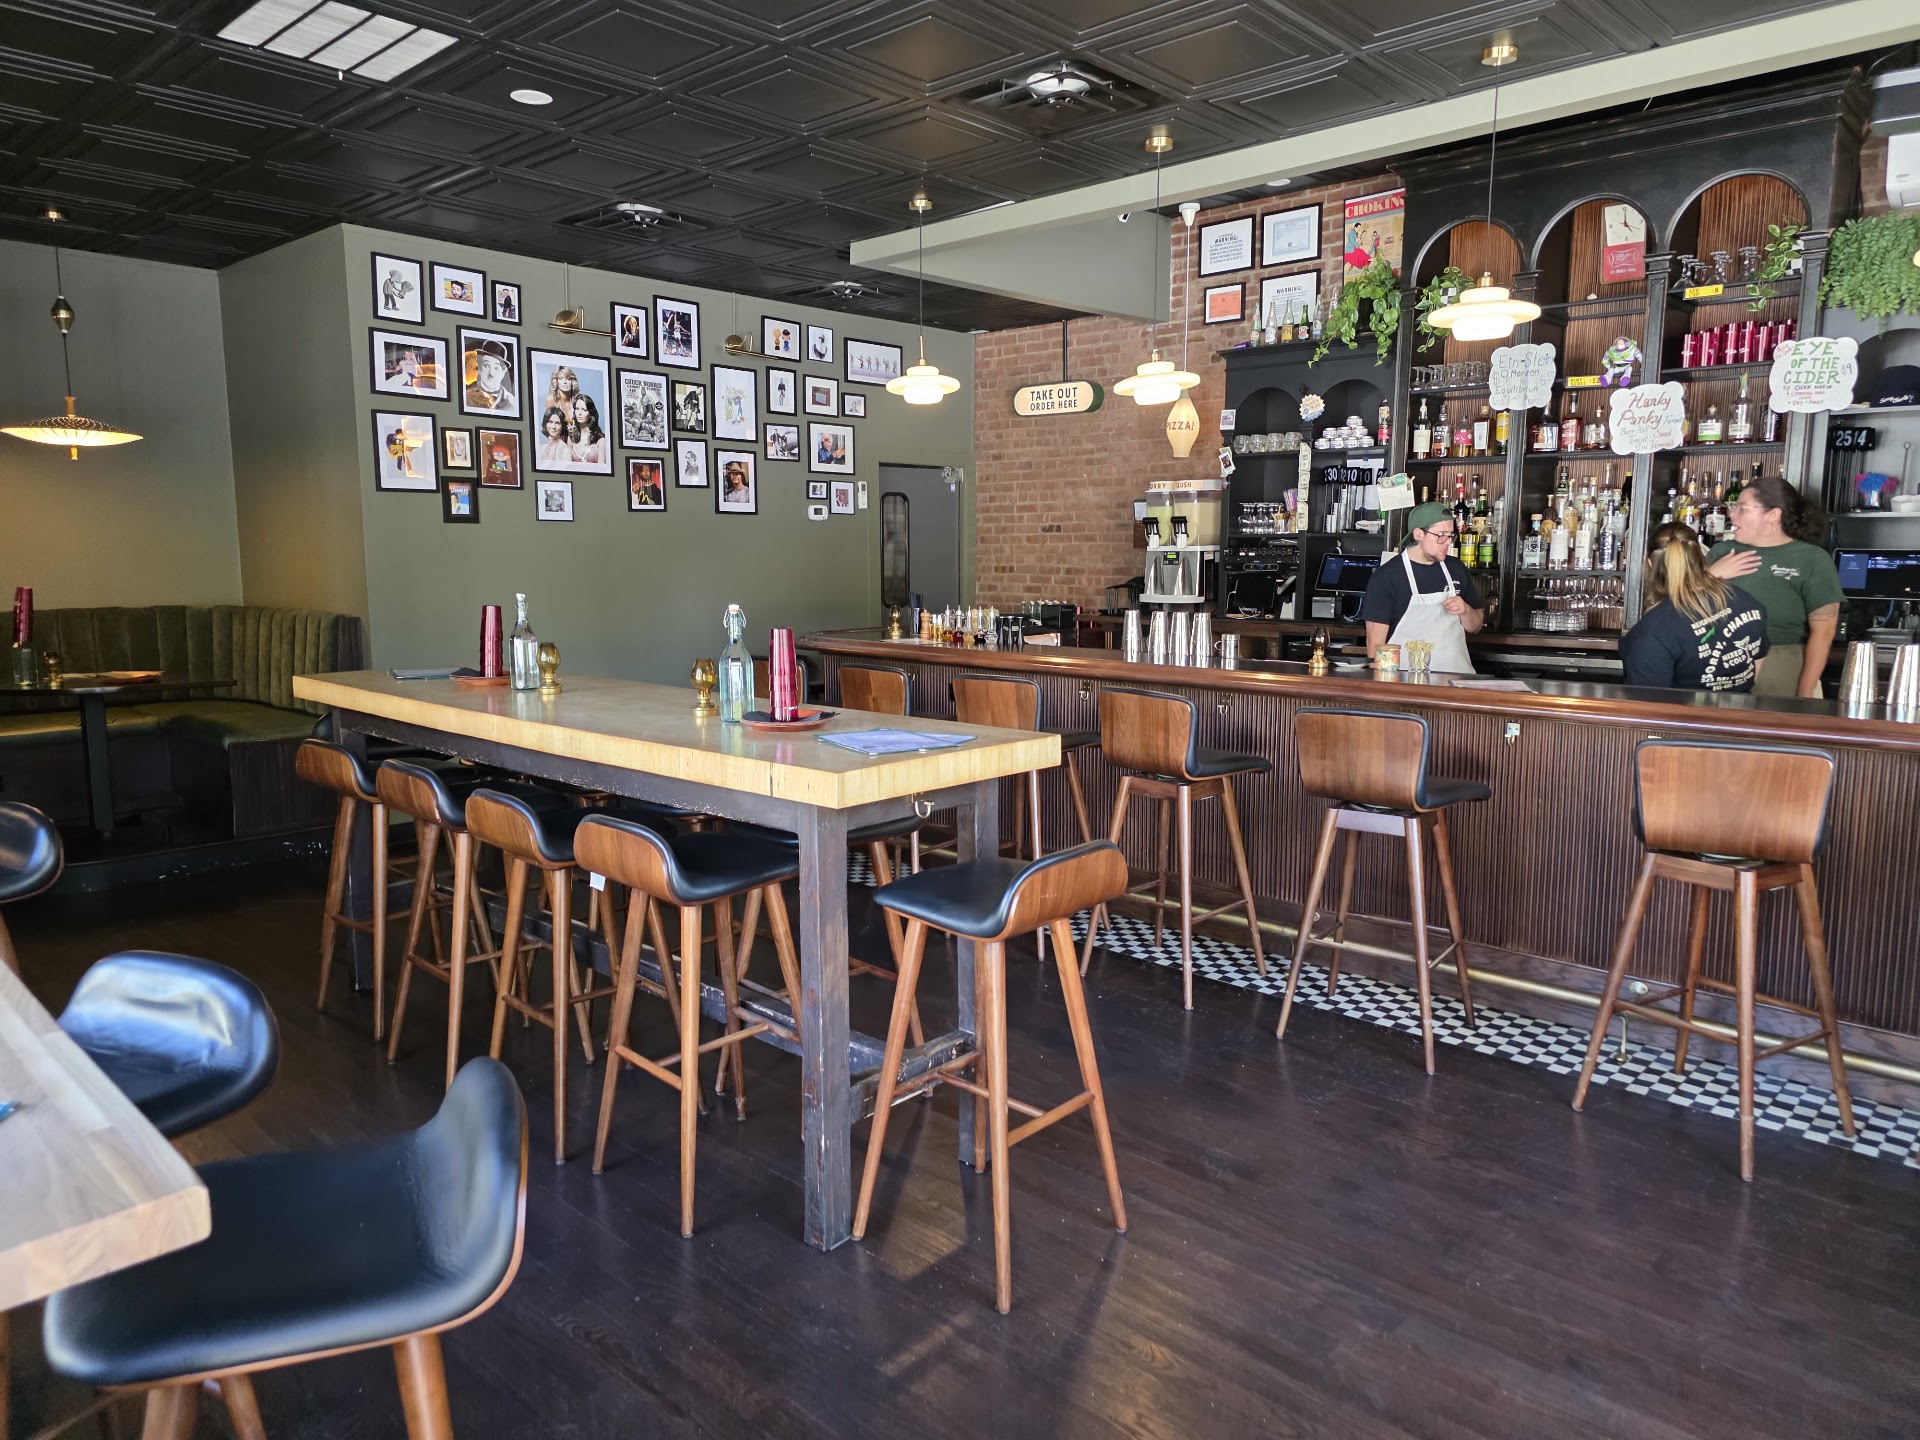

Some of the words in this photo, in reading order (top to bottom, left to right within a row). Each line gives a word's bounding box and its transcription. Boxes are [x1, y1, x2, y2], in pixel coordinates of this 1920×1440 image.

[1276, 285, 1303, 294] WARNING:
[1791, 341, 1839, 356] EYE
[1790, 358, 1808, 369] OF
[1810, 357, 1840, 369] THE
[1841, 363, 1853, 376] $9
[1783, 370, 1841, 385] CIDER
[1030, 389, 1054, 402] TAKE
[1057, 387, 1078, 399] OUT
[1629, 391, 1671, 411] Hanky
[1030, 401, 1056, 411] ORDER
[1058, 399, 1078, 409] HERE
[1616, 409, 1663, 430] Panky
[1347, 468, 1358, 482] 10
[1359, 470, 1371, 483] 10
[1693, 627, 1707, 637] BAR
[1697, 643, 1710, 652] BAR
[1701, 641, 1726, 679] SORRY,
[1723, 610, 1761, 637] CHARLIE
[1722, 649, 1743, 661] MIXED
